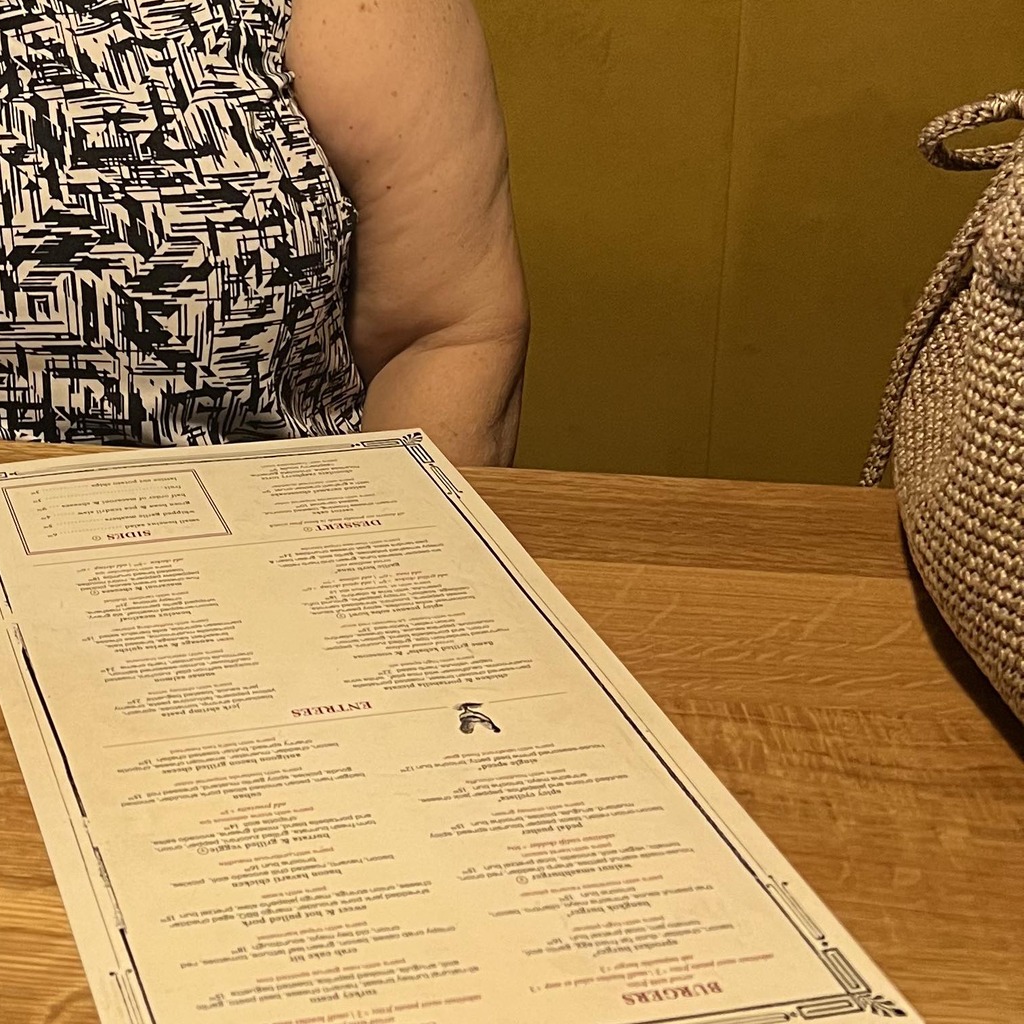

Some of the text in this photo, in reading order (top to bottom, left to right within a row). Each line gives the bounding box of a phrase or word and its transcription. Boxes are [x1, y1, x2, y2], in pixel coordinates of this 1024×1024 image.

[311, 519, 382, 531] DESSERT
[105, 530, 152, 539] SIDES
[289, 701, 372, 717] ENTREES
[619, 980, 724, 1006] BURGERS
